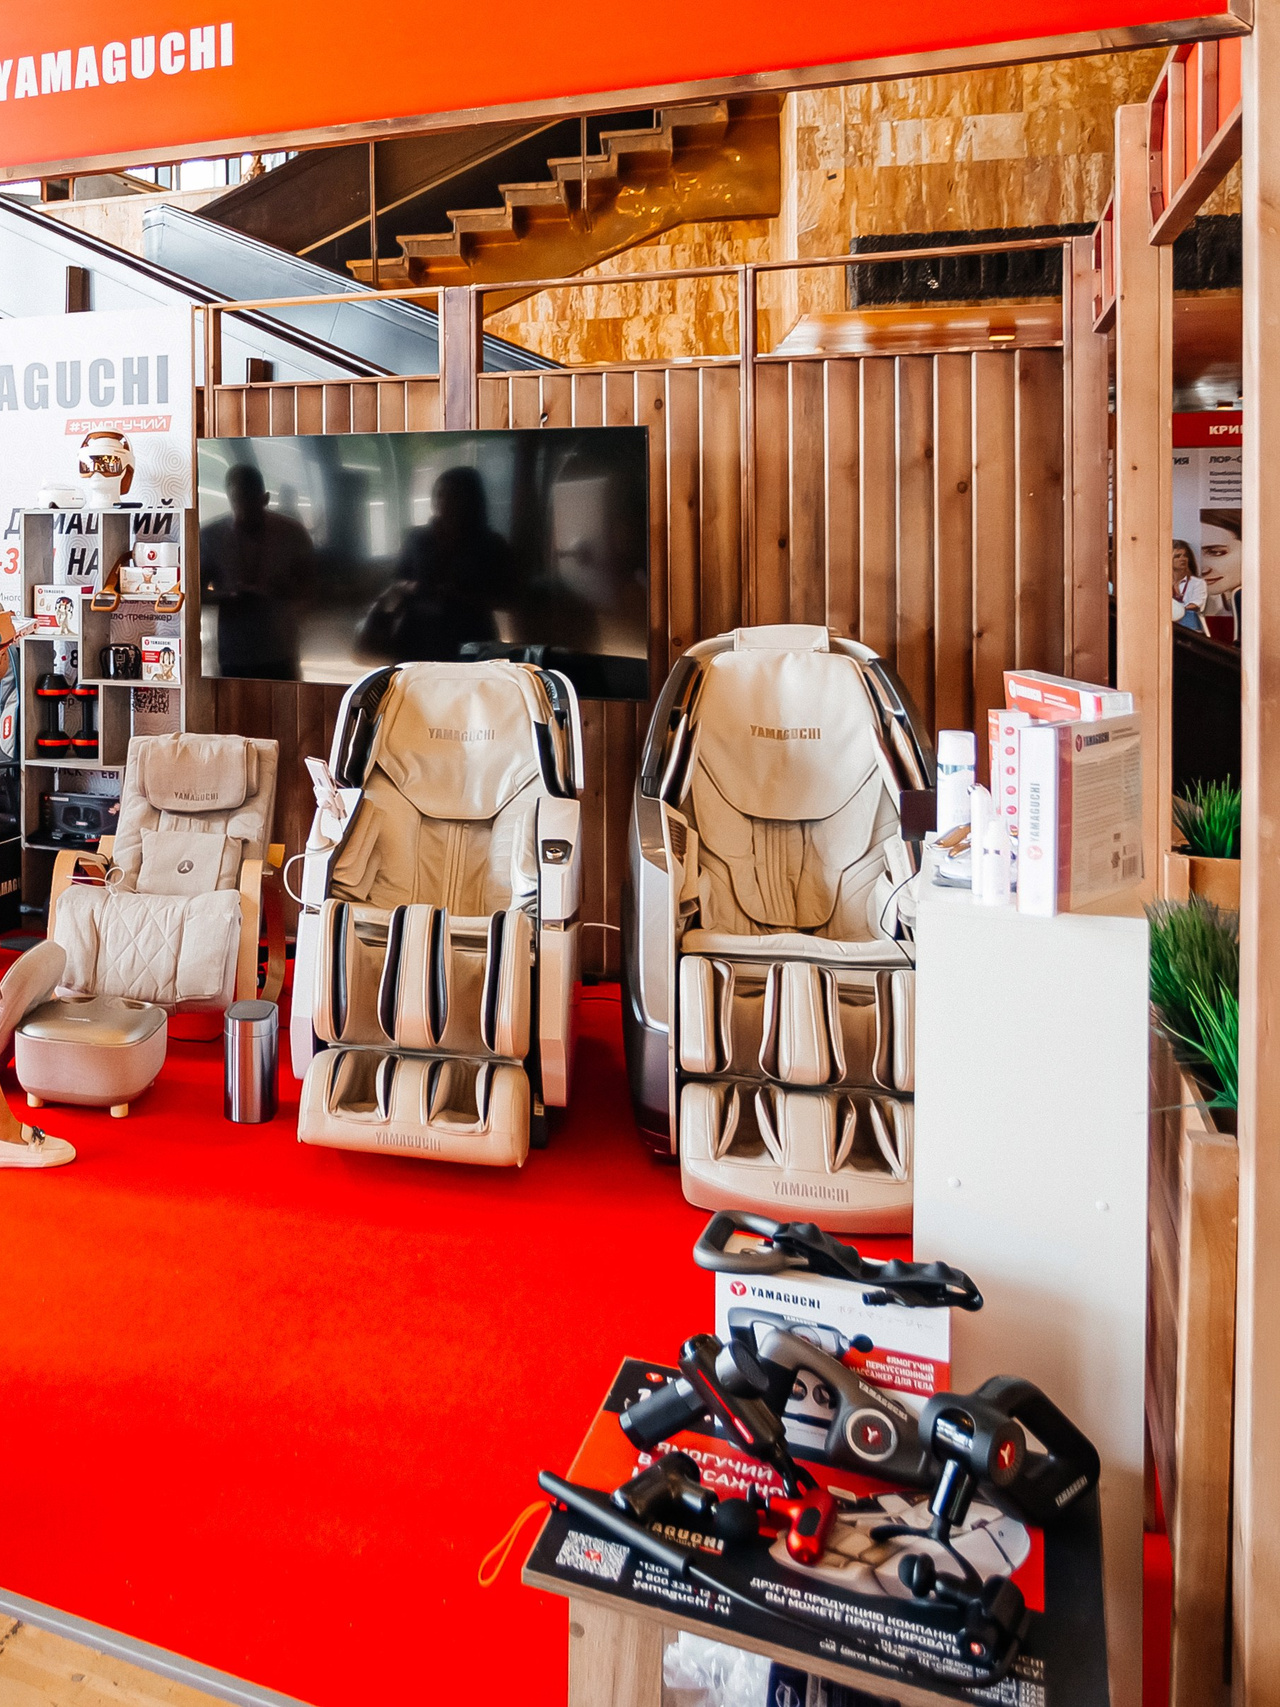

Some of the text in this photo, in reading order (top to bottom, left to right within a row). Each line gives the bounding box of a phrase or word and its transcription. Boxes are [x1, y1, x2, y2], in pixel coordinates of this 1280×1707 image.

[1209, 424, 1243, 435] КРИ
[427, 727, 495, 742] YAMAGUCHI
[749, 724, 822, 741] YAMAGUCHI
[173, 791, 219, 801] YAMAGUCHI
[1028, 782, 1041, 844] YAMAGUCHI
[374, 1131, 442, 1152] YAMAGUCHI
[772, 1179, 851, 1204] YAMAGUCHI
[750, 1286, 821, 1309] YAMAGUCHI
[865, 1359, 934, 1382] ПЕРКУССИОННЫЙ
[886, 1355, 934, 1373] #ЯМОГУЧИЙ
[894, 1376, 912, 1385] ДЛЯ
[913, 1379, 934, 1392] ТЕЛА
[858, 1380, 908, 1422] YAMAGUCHI
[1055, 1475, 1089, 1508] YAMAGUCHI
[632, 1578, 730, 1617] yamaguchi.ru
[750, 1576, 802, 1600] ДРУГУЮ
[803, 1592, 885, 1623] ПРОДУКЦИЮ
[765, 1590, 786, 1607] ВЫ
[787, 1599, 843, 1623] МОЖЕТЕ
[844, 1613, 962, 1656] ПРОТЕСТИРОВАТЬ
